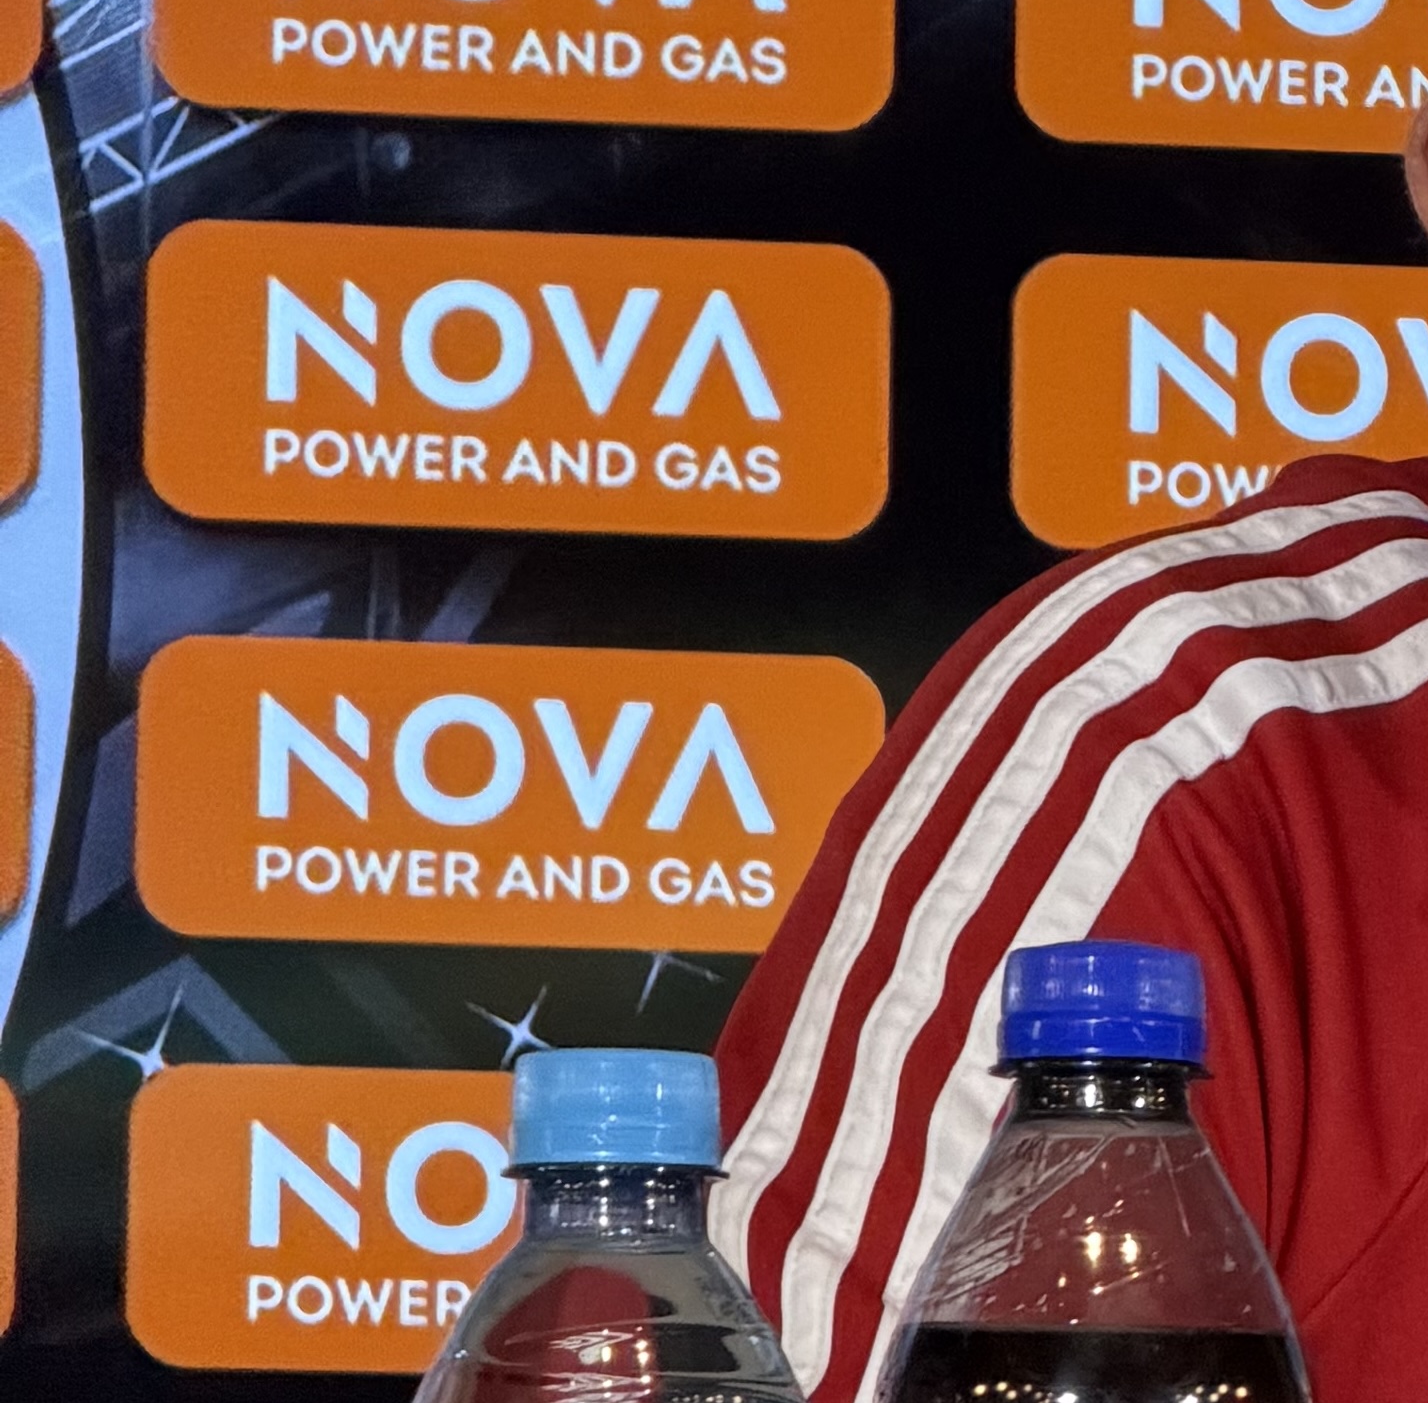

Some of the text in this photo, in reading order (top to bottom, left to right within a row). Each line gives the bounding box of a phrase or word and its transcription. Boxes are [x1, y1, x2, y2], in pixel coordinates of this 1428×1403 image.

[271, 17, 787, 85] POWER AND GAS
[1131, 53, 1349, 107] POWER
[266, 276, 782, 421] NOVA
[263, 428, 782, 494] POWER AND GAS
[1128, 460, 1283, 509] POW
[257, 692, 776, 835] NOVA
[255, 845, 776, 908] POWER AND GAS
[249, 1119, 517, 1256] NO
[247, 1274, 474, 1327] POWER
